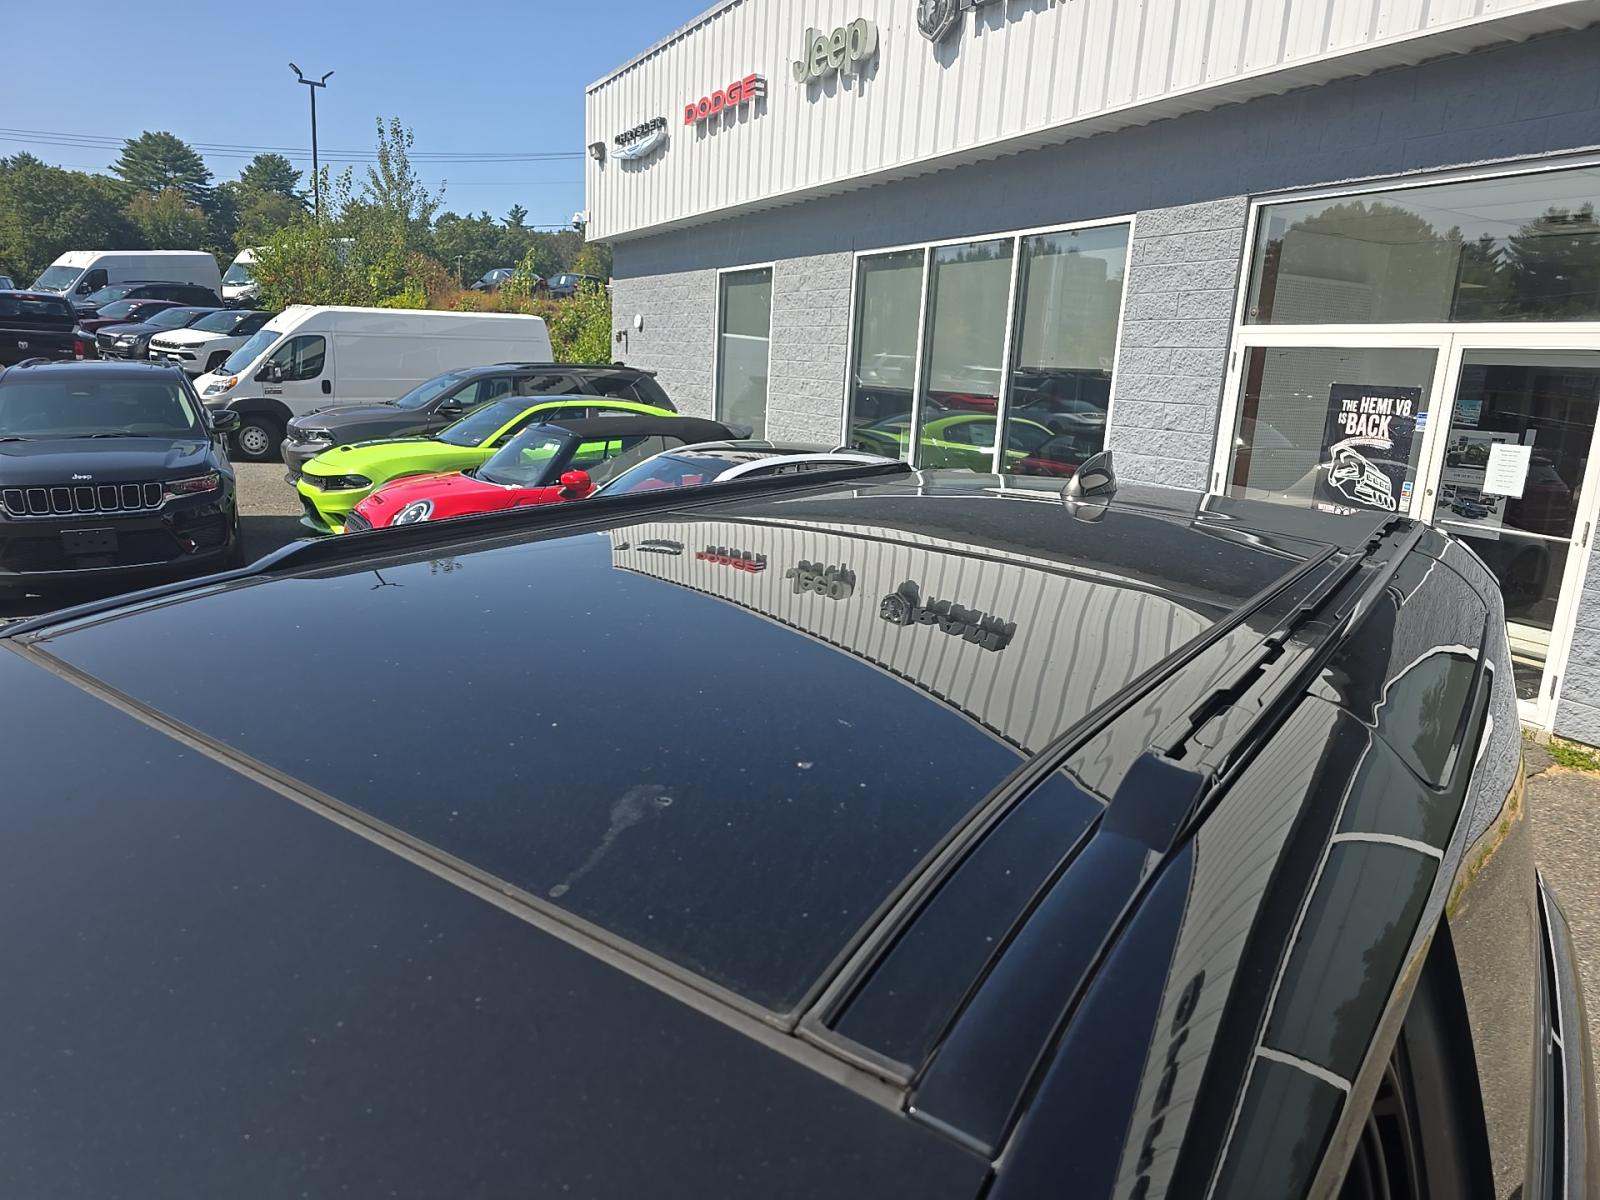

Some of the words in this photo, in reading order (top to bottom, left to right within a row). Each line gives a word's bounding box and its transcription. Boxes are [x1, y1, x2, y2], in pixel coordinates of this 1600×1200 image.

[793, 17, 877, 83] Jeep
[684, 73, 766, 125] DODGE
[1338, 411, 1348, 425] IS
[1345, 412, 1392, 440] BACK
[1342, 399, 1359, 412] THE
[1395, 399, 1412, 417] V8
